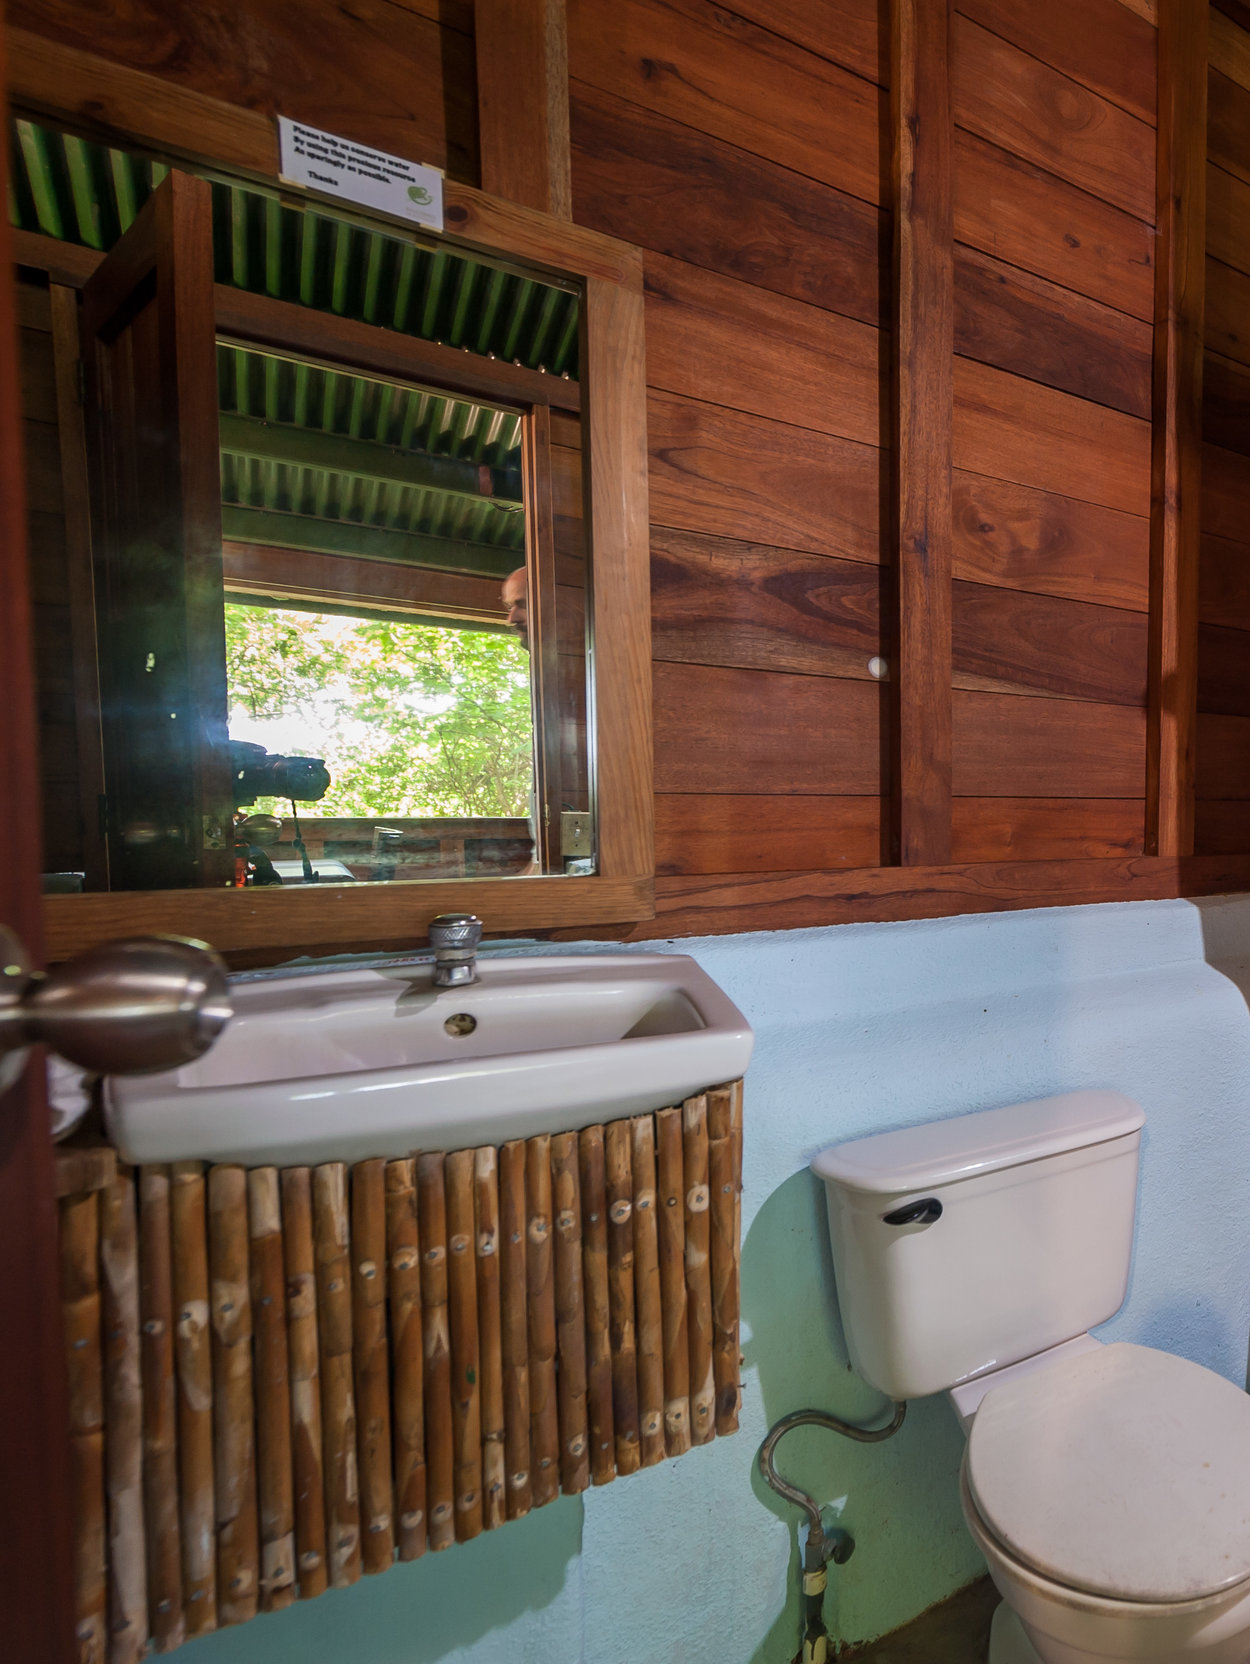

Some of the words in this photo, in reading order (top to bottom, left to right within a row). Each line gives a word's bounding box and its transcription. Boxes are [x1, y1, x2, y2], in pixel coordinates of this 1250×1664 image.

[293, 125, 320, 140] Please
[321, 135, 338, 147] help
[340, 143, 350, 151] us
[351, 147, 386, 163] conserve
[387, 160, 410, 171] water
[293, 135, 304, 146] By
[307, 142, 329, 155] using
[330, 148, 346, 160] this
[347, 155, 381, 171] precious
[294, 146, 305, 155] As
[306, 152, 345, 169] sparingly
[307, 170, 338, 186] Thanks
